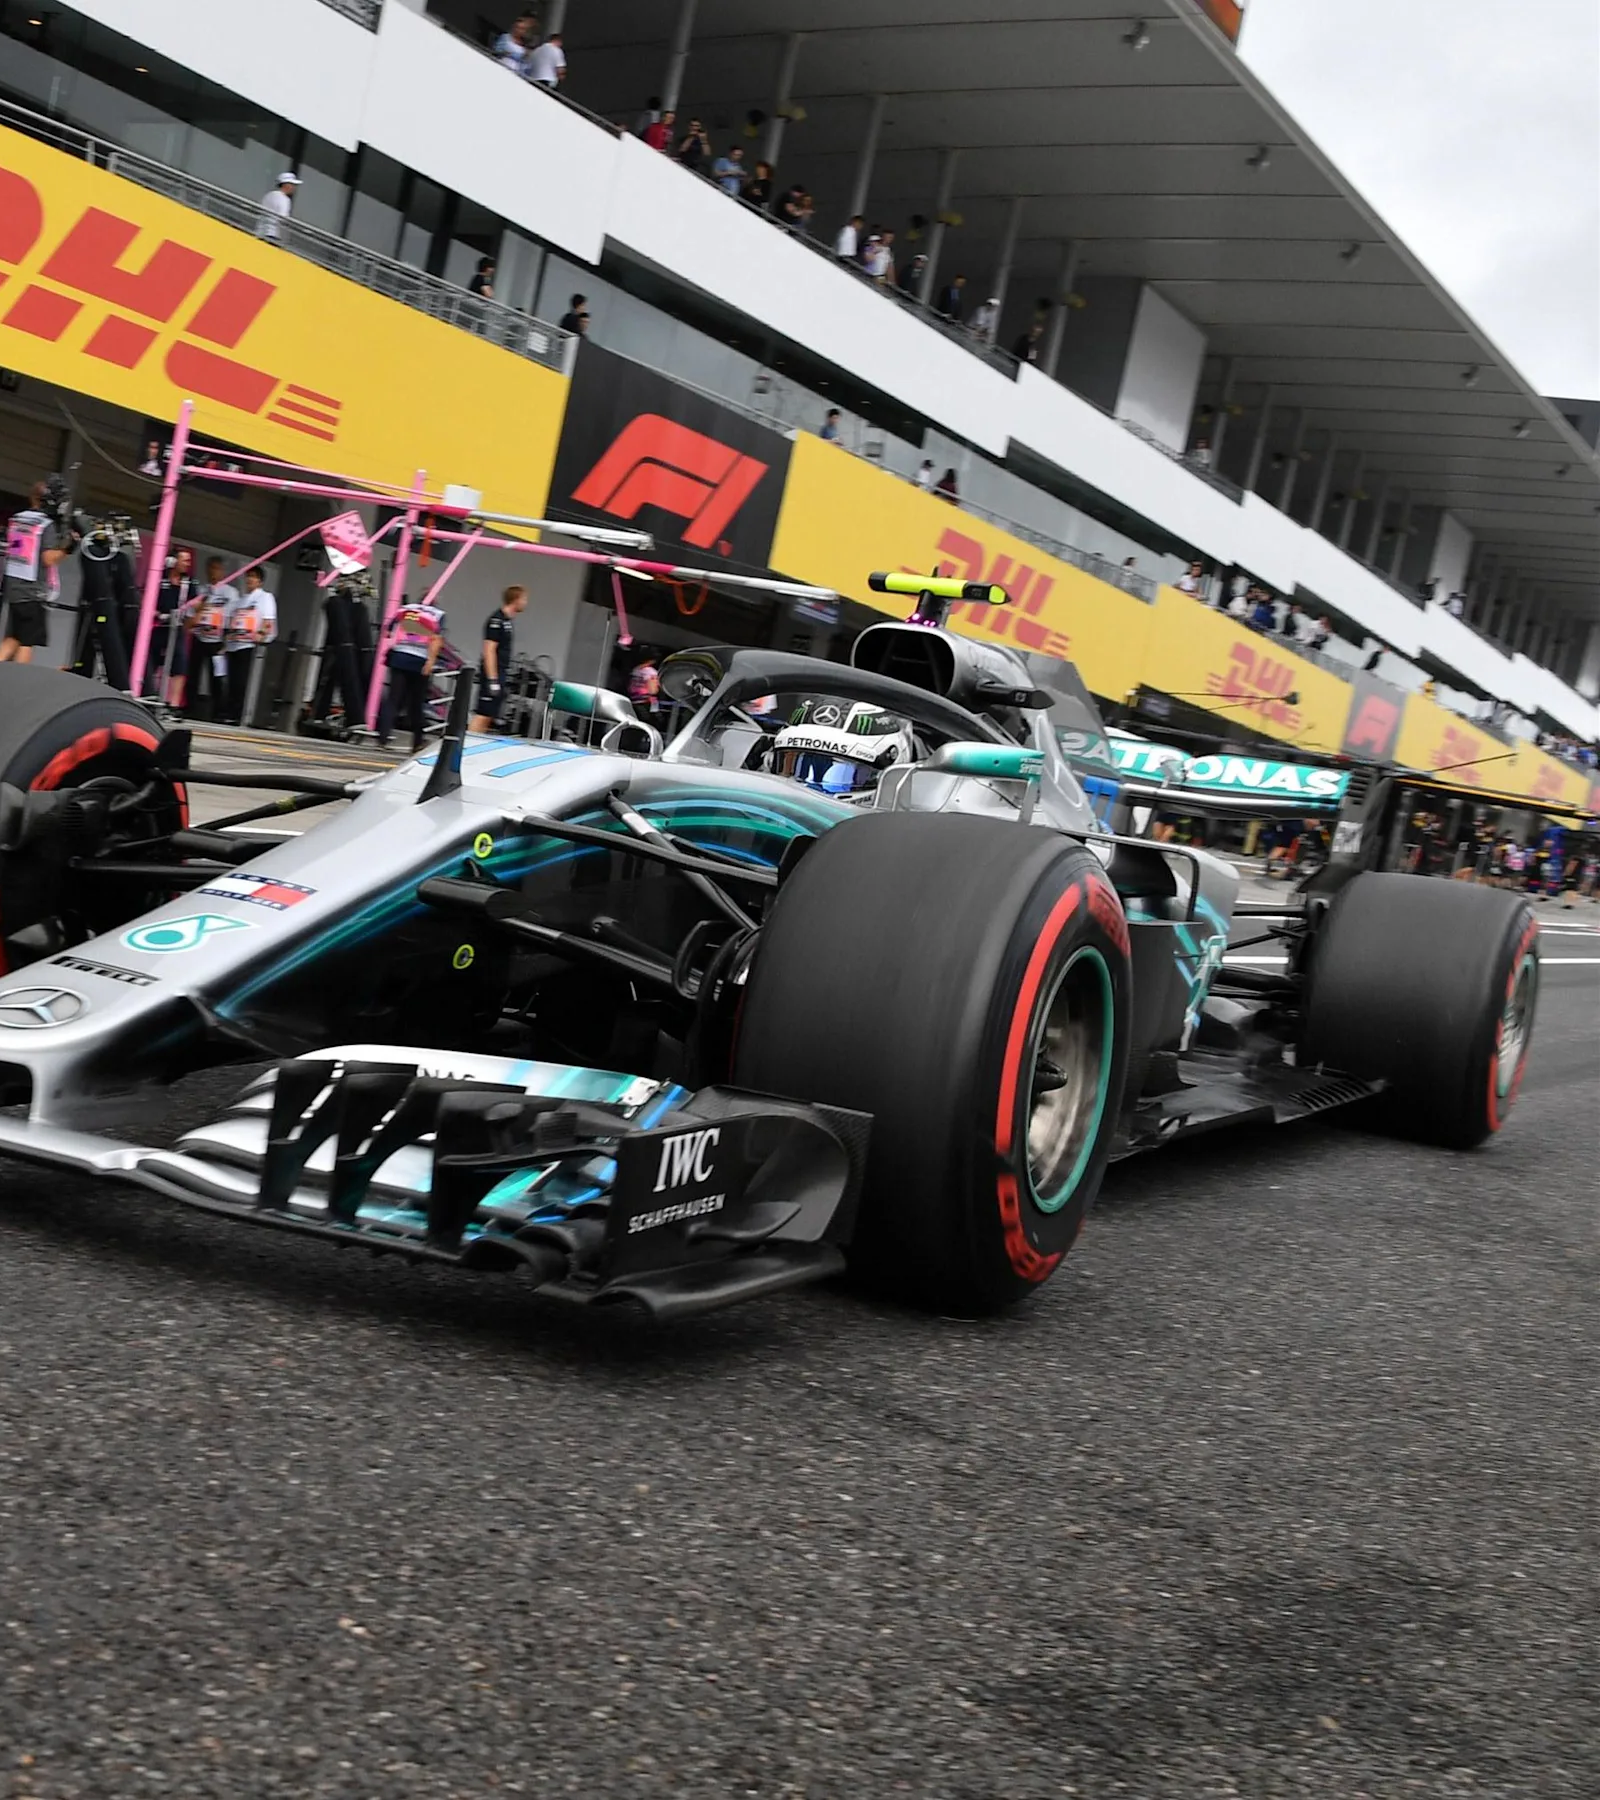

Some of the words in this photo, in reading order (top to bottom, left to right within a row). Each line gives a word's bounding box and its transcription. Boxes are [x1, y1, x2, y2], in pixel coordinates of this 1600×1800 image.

[570, 413, 770, 550] F1
[930, 527, 1056, 650] DHL
[787, 737, 847, 754] PETRONAS
[855, 750, 875, 760] EPSON
[49, 955, 161, 986] PIRELLI
[653, 1127, 721, 1193] IWC
[627, 1193, 726, 1234] SCHAFFHAUSEN
